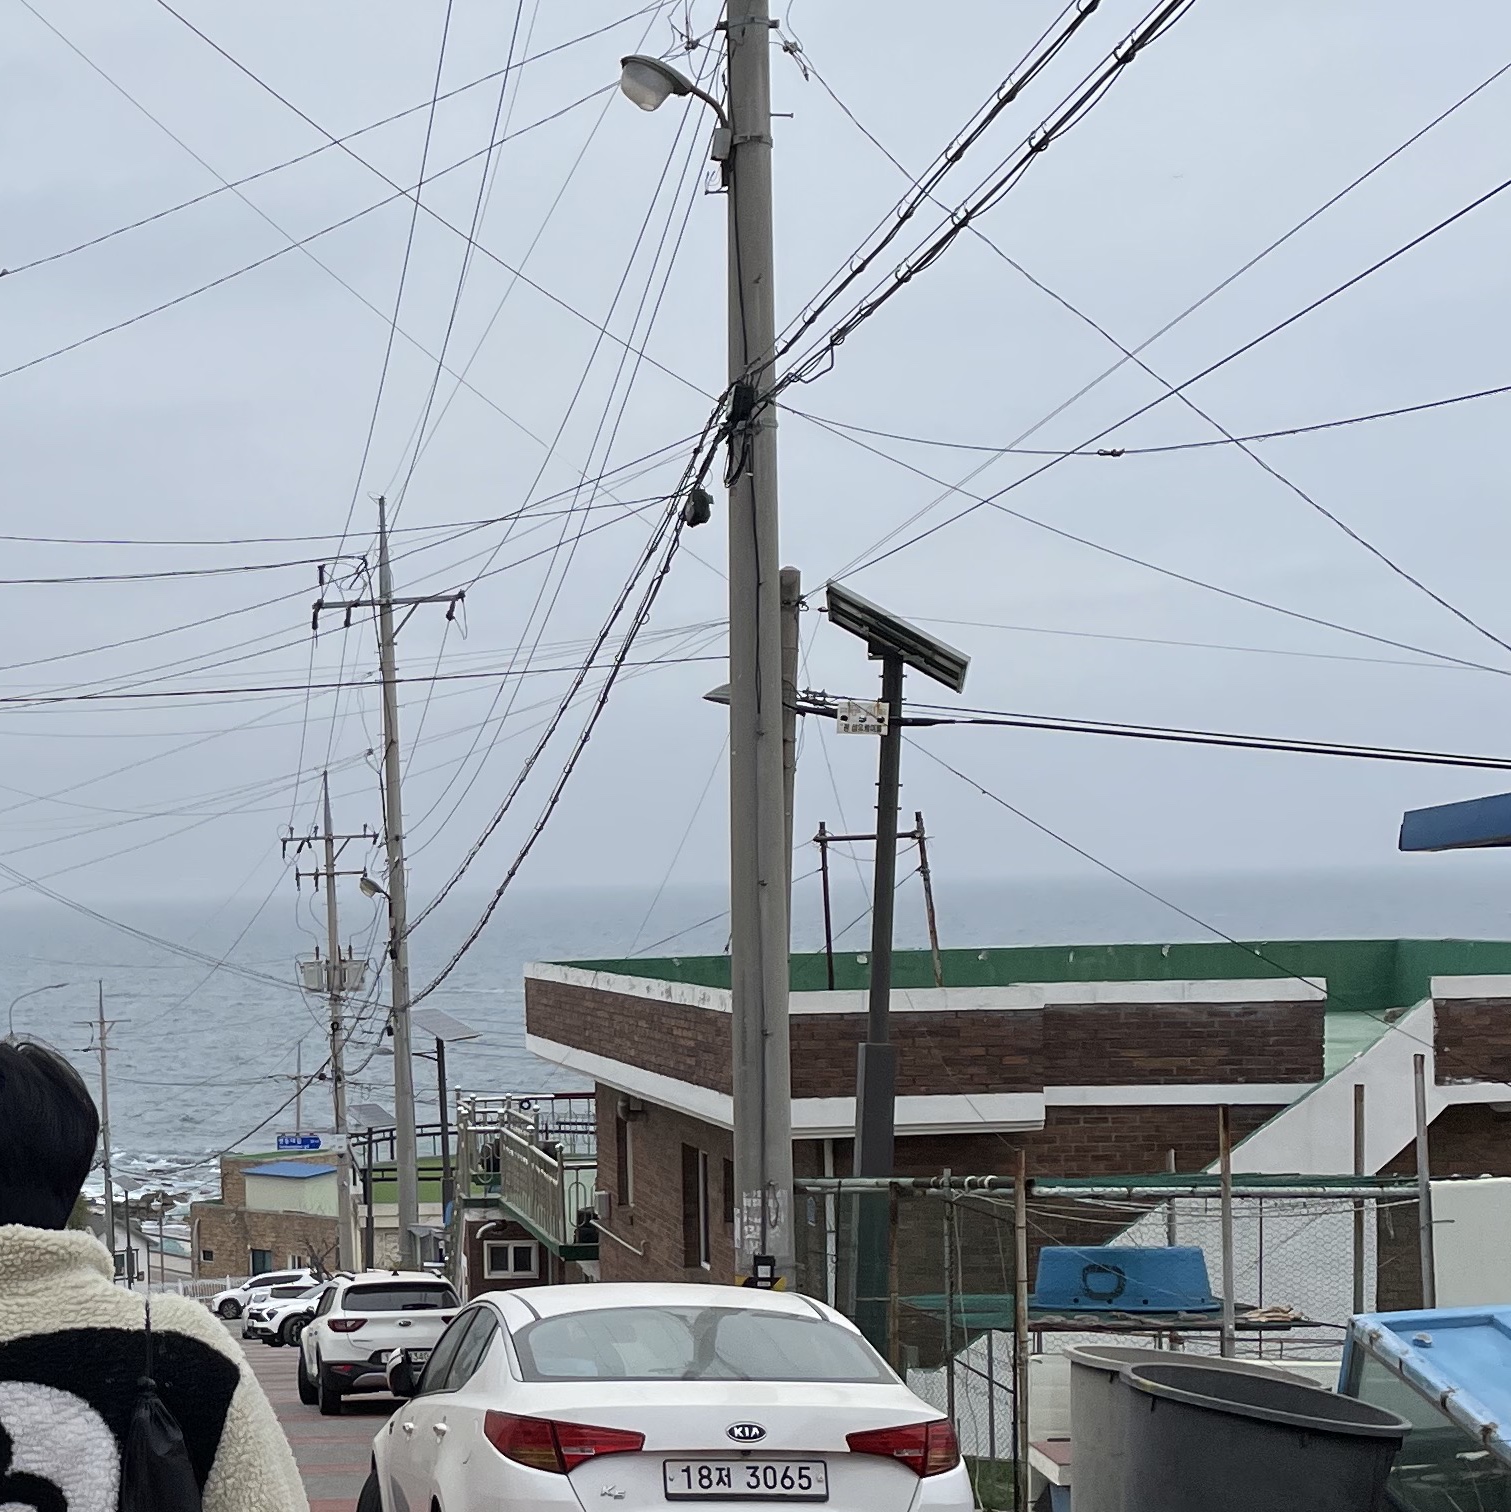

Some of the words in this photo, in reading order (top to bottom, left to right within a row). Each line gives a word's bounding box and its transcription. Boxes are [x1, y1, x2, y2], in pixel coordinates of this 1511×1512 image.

[732, 1425, 761, 1439] KIA
[680, 1464, 732, 1490] 18저
[745, 1465, 813, 1491] 3065
[600, 1484, 626, 1500] K5
